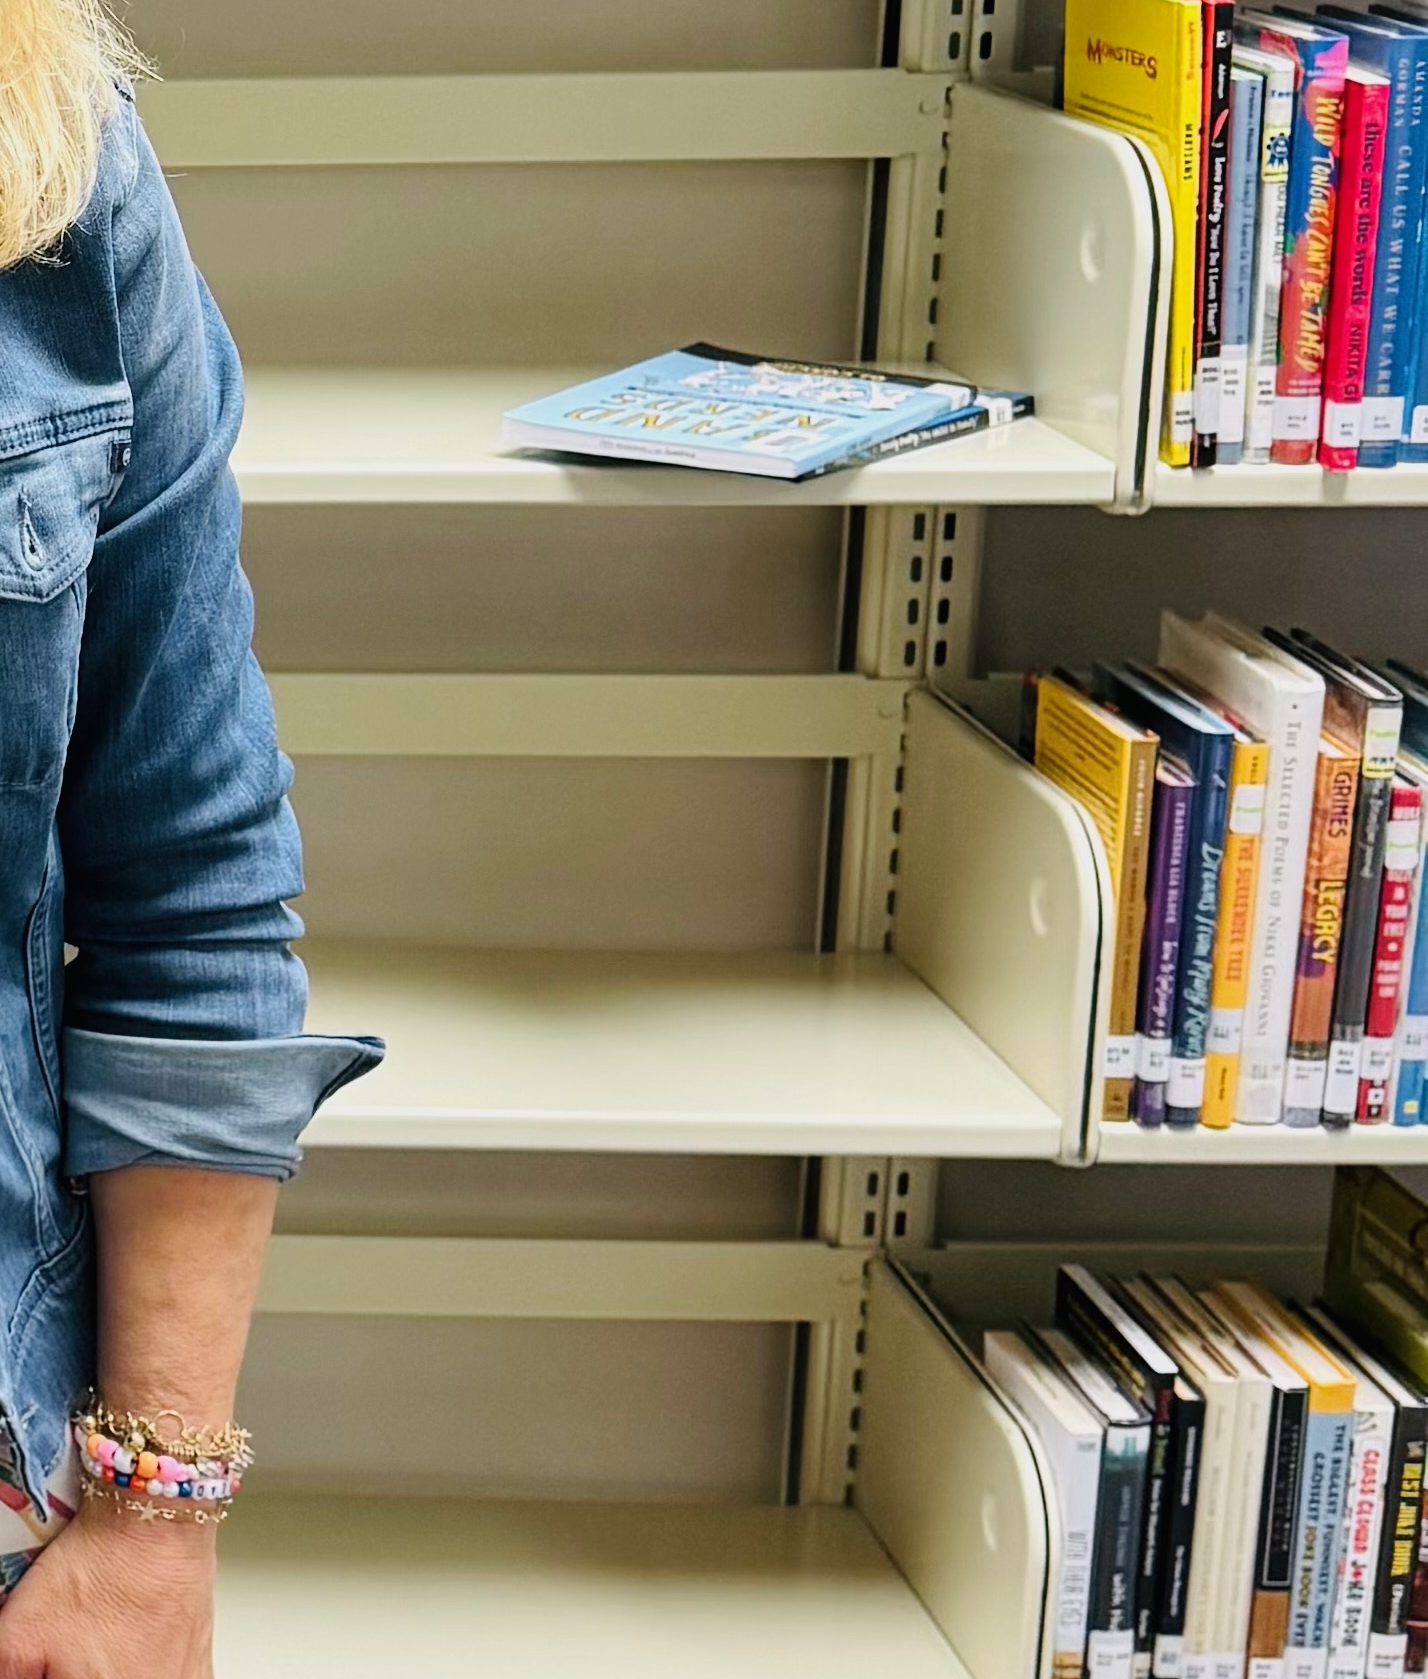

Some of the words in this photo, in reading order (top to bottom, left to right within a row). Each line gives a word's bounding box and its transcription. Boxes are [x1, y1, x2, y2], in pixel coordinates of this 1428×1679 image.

[1087, 37, 1158, 79] MONSTERS
[1393, 57, 1409, 128] GORMAN
[1410, 61, 1426, 126] AMANDA
[1312, 97, 1344, 147] WILD
[1362, 123, 1380, 174] these
[1393, 145, 1412, 197] CALL
[1304, 152, 1334, 225] TONGUES
[1359, 178, 1372, 206] are
[1356, 214, 1372, 243] the
[1390, 205, 1407, 230] US
[1305, 229, 1331, 281] CAN'T
[1350, 250, 1368, 306] words
[1384, 239, 1402, 297] WHAT
[1299, 279, 1324, 303] BE
[1295, 306, 1325, 373] TAMED
[1382, 305, 1398, 334] WE
[1345, 324, 1362, 380] NIKITA
[1285, 719, 1302, 748] THE
[1276, 755, 1298, 831] SELECTED
[1328, 770, 1354, 839] GRIMES
[1200, 841, 1224, 911] Dreams
[1270, 836, 1290, 884] POEMS
[1270, 889, 1282, 907] OF
[1311, 878, 1345, 964] LEGACY
[1262, 914, 1283, 958] NIKKI
[1255, 963, 1278, 1037] GIOVANNI
[1332, 1425, 1346, 1451] THE
[1361, 1450, 1380, 1496] CLASS
[1298, 1566, 1314, 1608] BOOK
